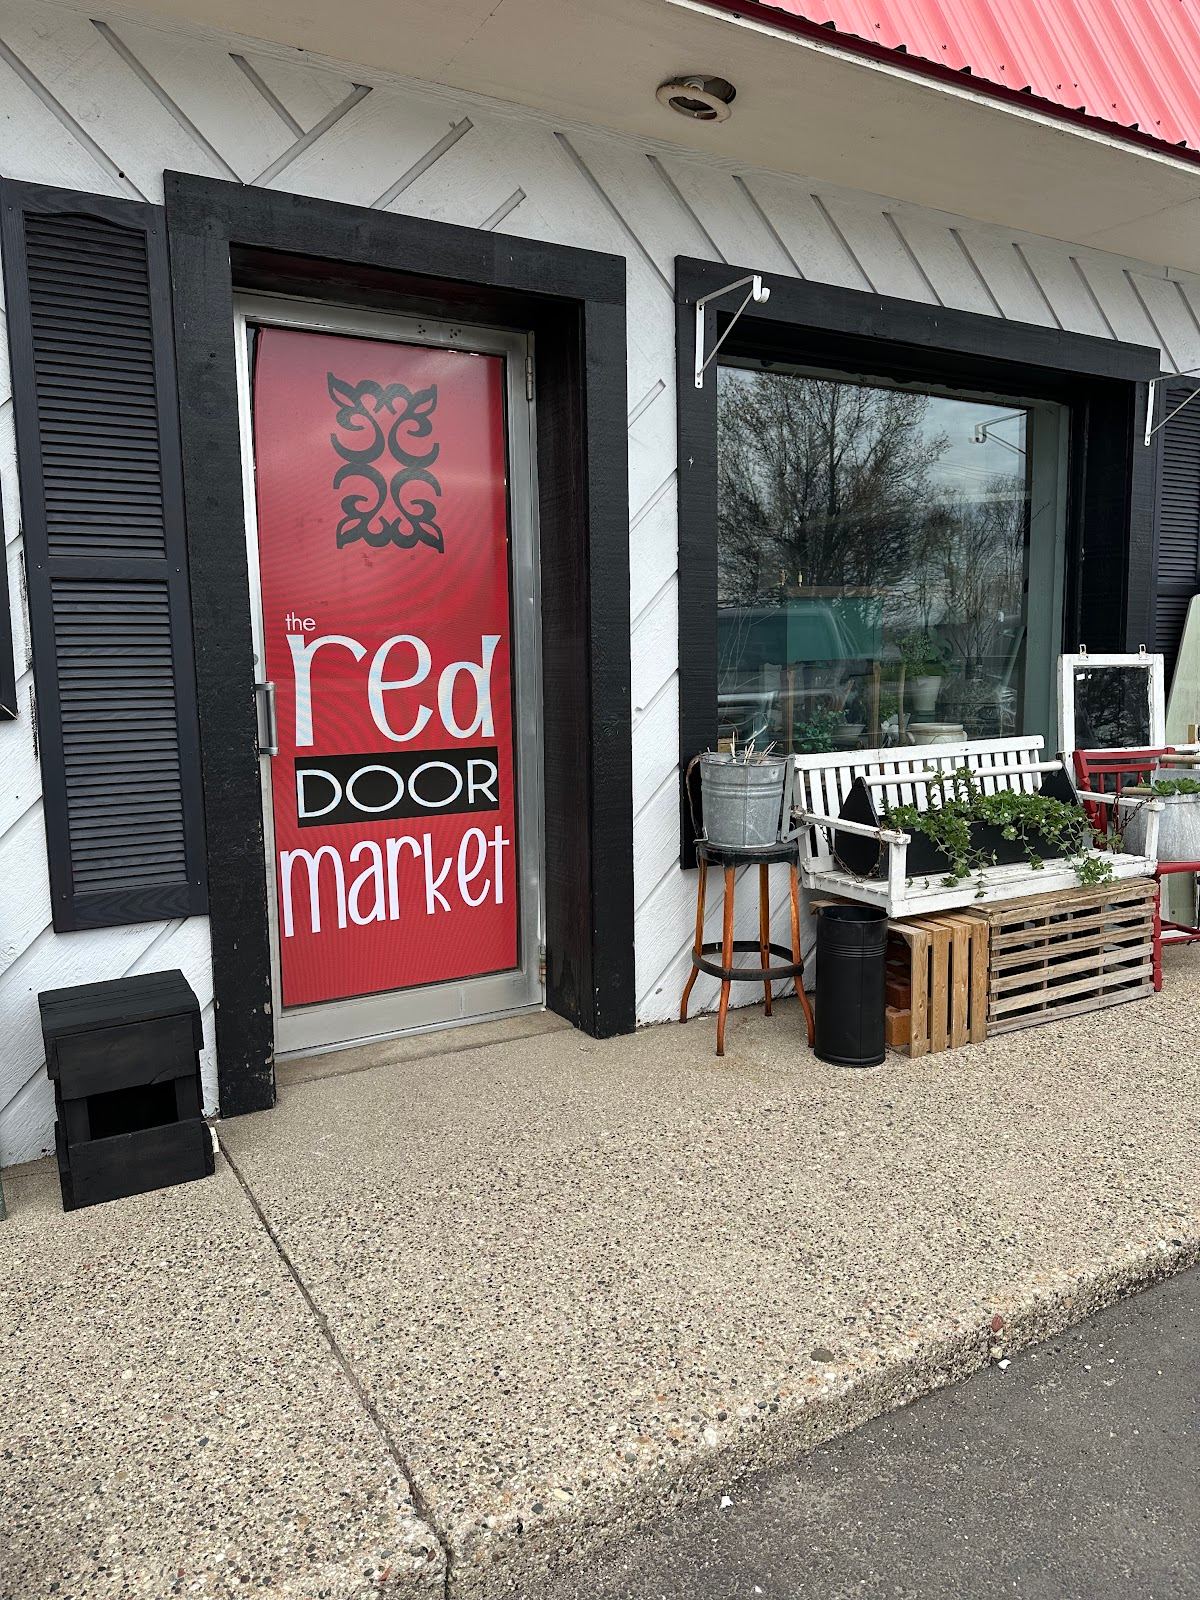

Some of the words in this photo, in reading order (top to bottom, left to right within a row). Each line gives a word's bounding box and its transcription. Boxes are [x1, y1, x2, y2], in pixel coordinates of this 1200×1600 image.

[285, 612, 316, 631] the
[286, 634, 502, 747] red
[296, 759, 498, 819] DOOR
[279, 825, 510, 937] market
